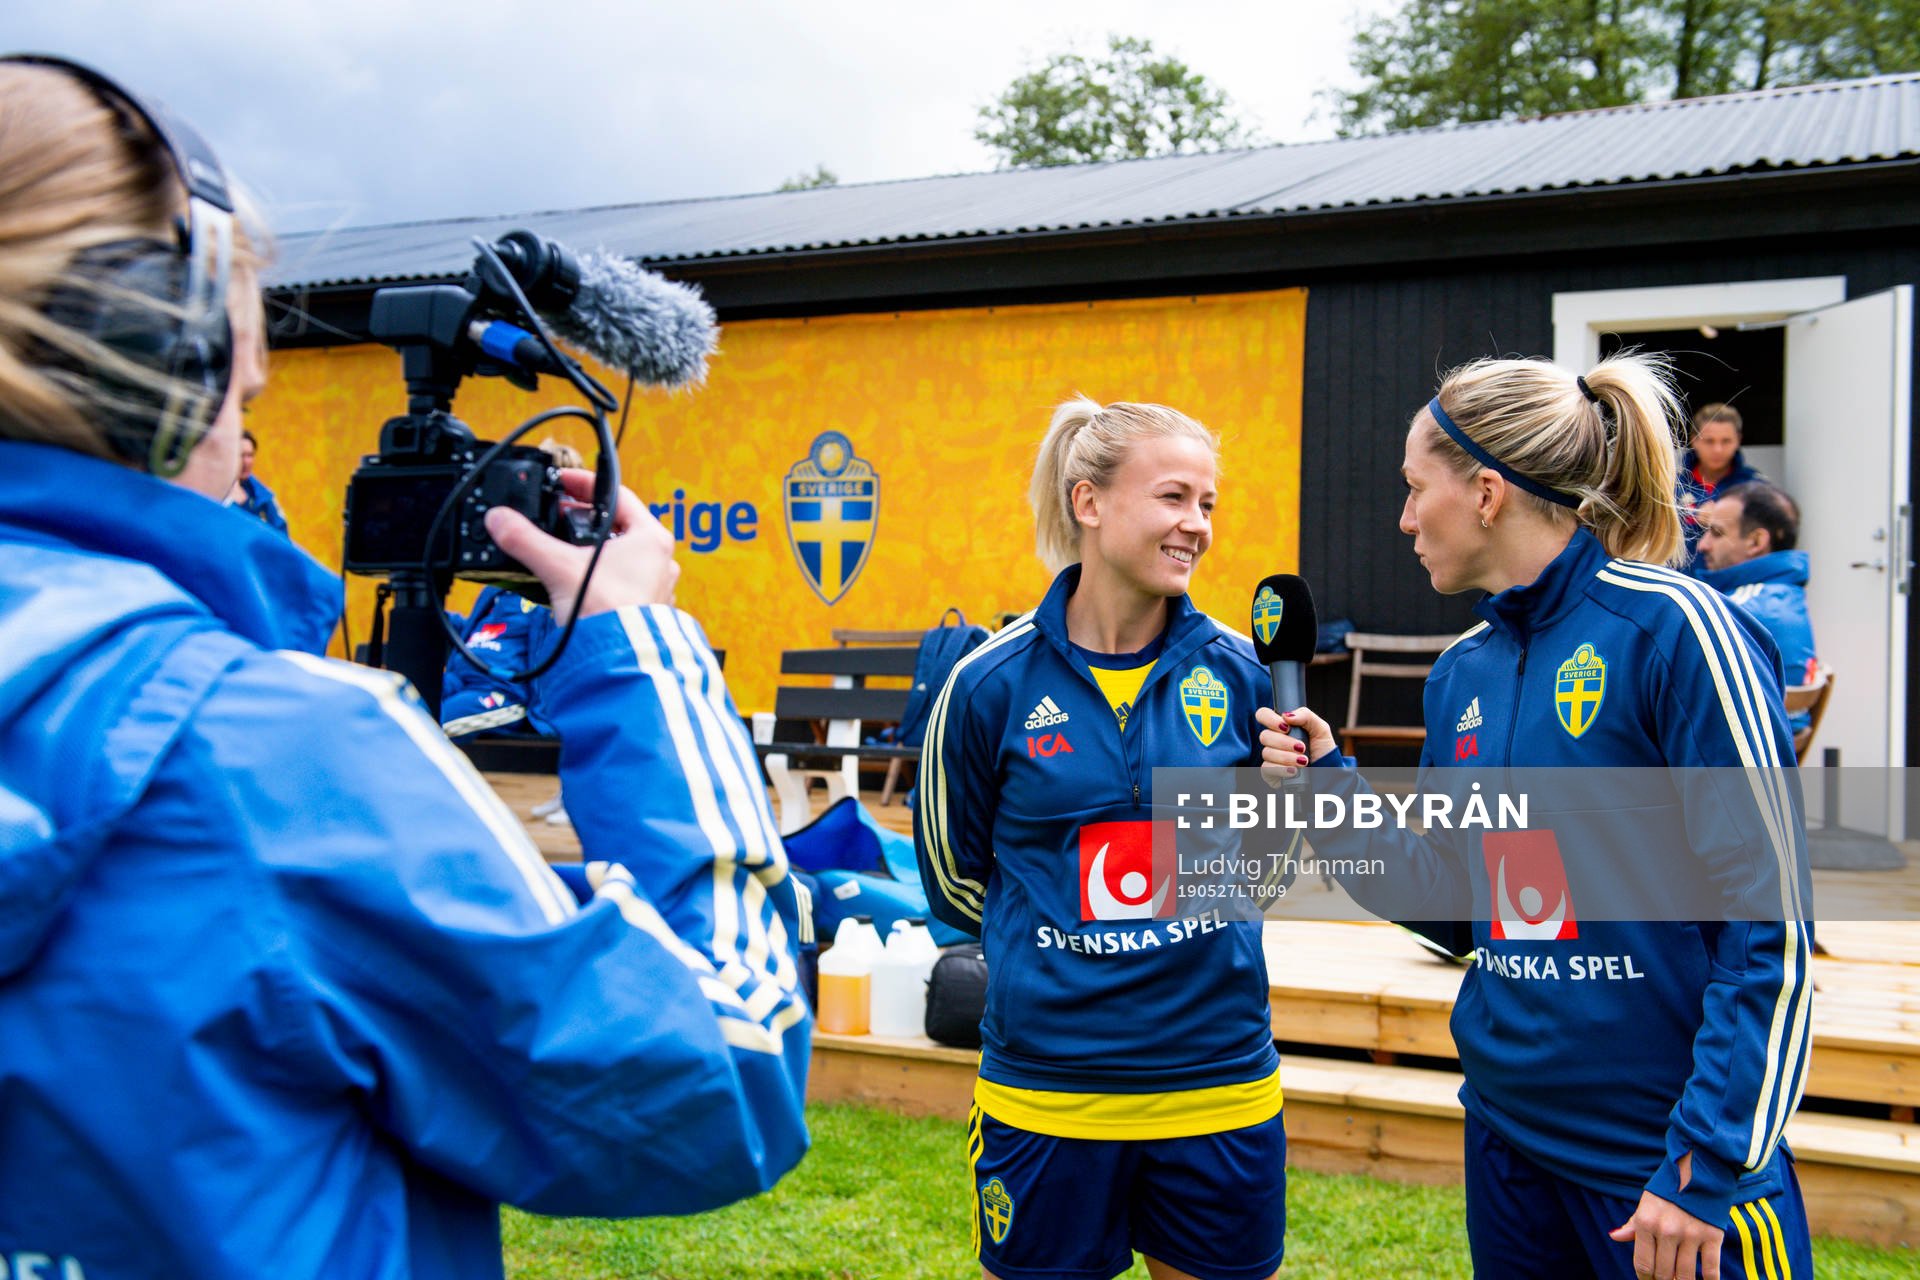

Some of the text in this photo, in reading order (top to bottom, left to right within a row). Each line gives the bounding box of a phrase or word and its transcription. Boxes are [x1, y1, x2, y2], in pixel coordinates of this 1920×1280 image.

[798, 481, 863, 495] SVERIGE
[1564, 669, 1598, 679] SVERIGE
[1187, 688, 1221, 698] SVERIGE
[1024, 712, 1070, 730] adidas
[1456, 715, 1483, 733] adidas
[1026, 732, 1074, 759] ICA
[1455, 733, 1479, 763] ICA
[1037, 907, 1228, 954] SVENSKA SPEL
[1475, 946, 1645, 980] SVNSKA SPEL
